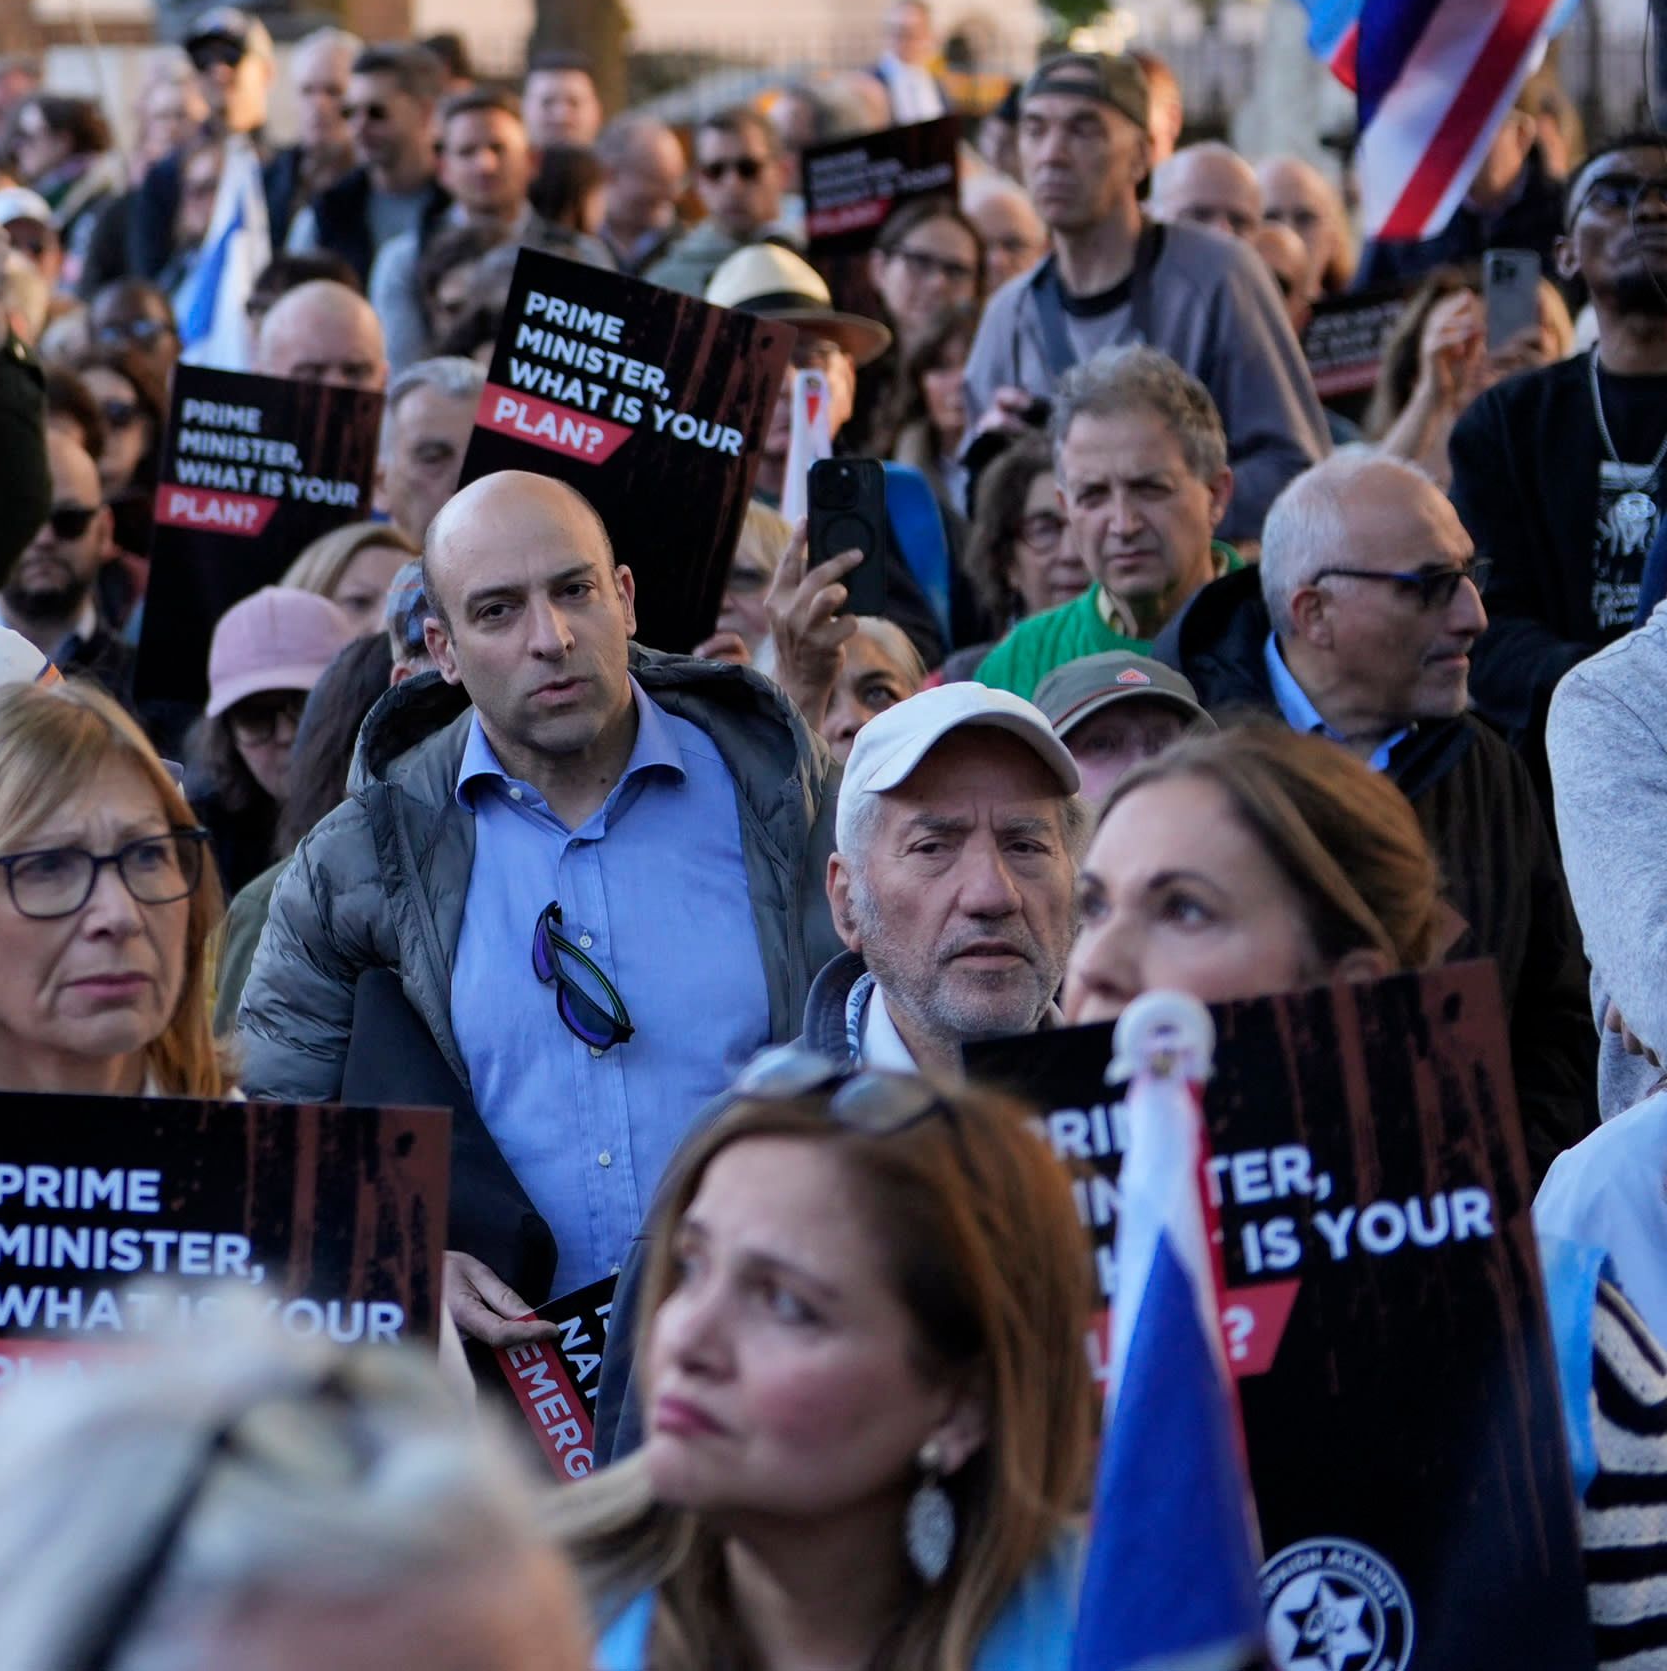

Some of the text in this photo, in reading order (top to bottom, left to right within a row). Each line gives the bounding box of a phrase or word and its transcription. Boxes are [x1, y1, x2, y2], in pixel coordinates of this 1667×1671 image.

[524, 290, 625, 345] PRIME
[515, 323, 671, 402] MINISTER,
[181, 397, 263, 434] PRIME
[493, 395, 605, 454] PLAN?
[509, 356, 744, 457] WHAT IS YOUR
[178, 428, 304, 474] MINISTER,
[169, 491, 259, 529] PLAN?
[175, 457, 361, 509] WHAT IS YOUR
[1242, 1187, 1495, 1275] IS YOUR
[267, 1297, 405, 1345] OUR
[505, 1342, 596, 1479] EMERG
